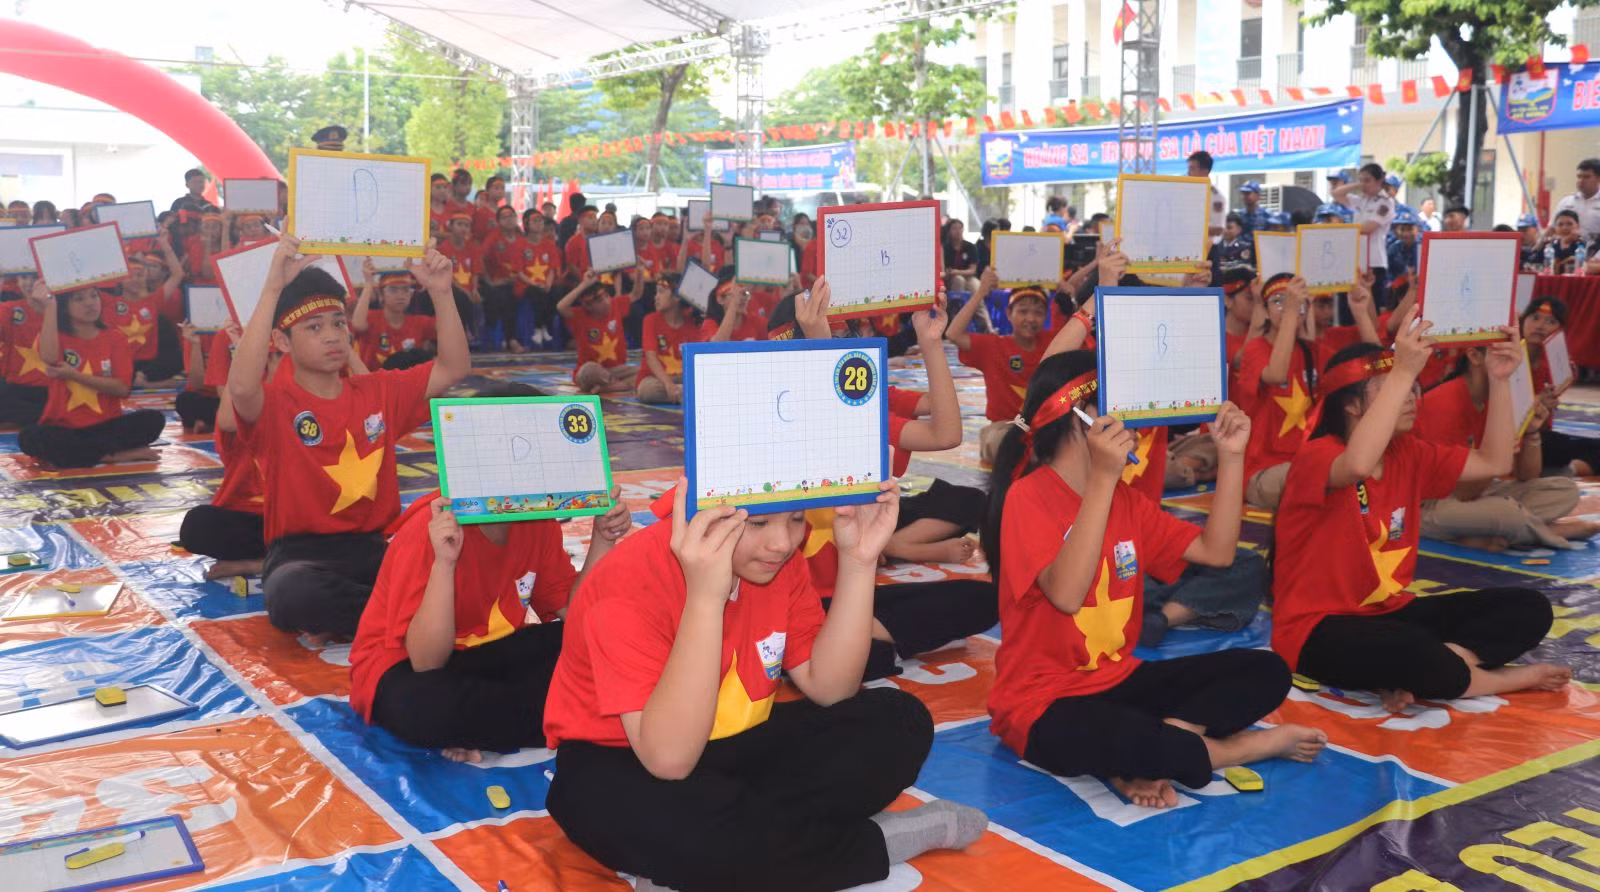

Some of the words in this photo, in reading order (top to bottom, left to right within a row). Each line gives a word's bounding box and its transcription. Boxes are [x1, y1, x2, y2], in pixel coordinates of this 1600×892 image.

[1070, 143, 1088, 166] SA
[1160, 136, 1179, 160] SA
[1205, 125, 1237, 156] CỦA
[1241, 124, 1276, 159] VIỆT
[1280, 125, 1326, 150] NAM!
[352, 167, 379, 224] D
[881, 249, 890, 267] B
[1321, 240, 1337, 270] B
[1157, 323, 1168, 357] B
[844, 366, 868, 391] 28
[777, 389, 795, 423] C
[301, 419, 318, 438] 38
[567, 414, 589, 433] 33
[511, 434, 532, 463] D
